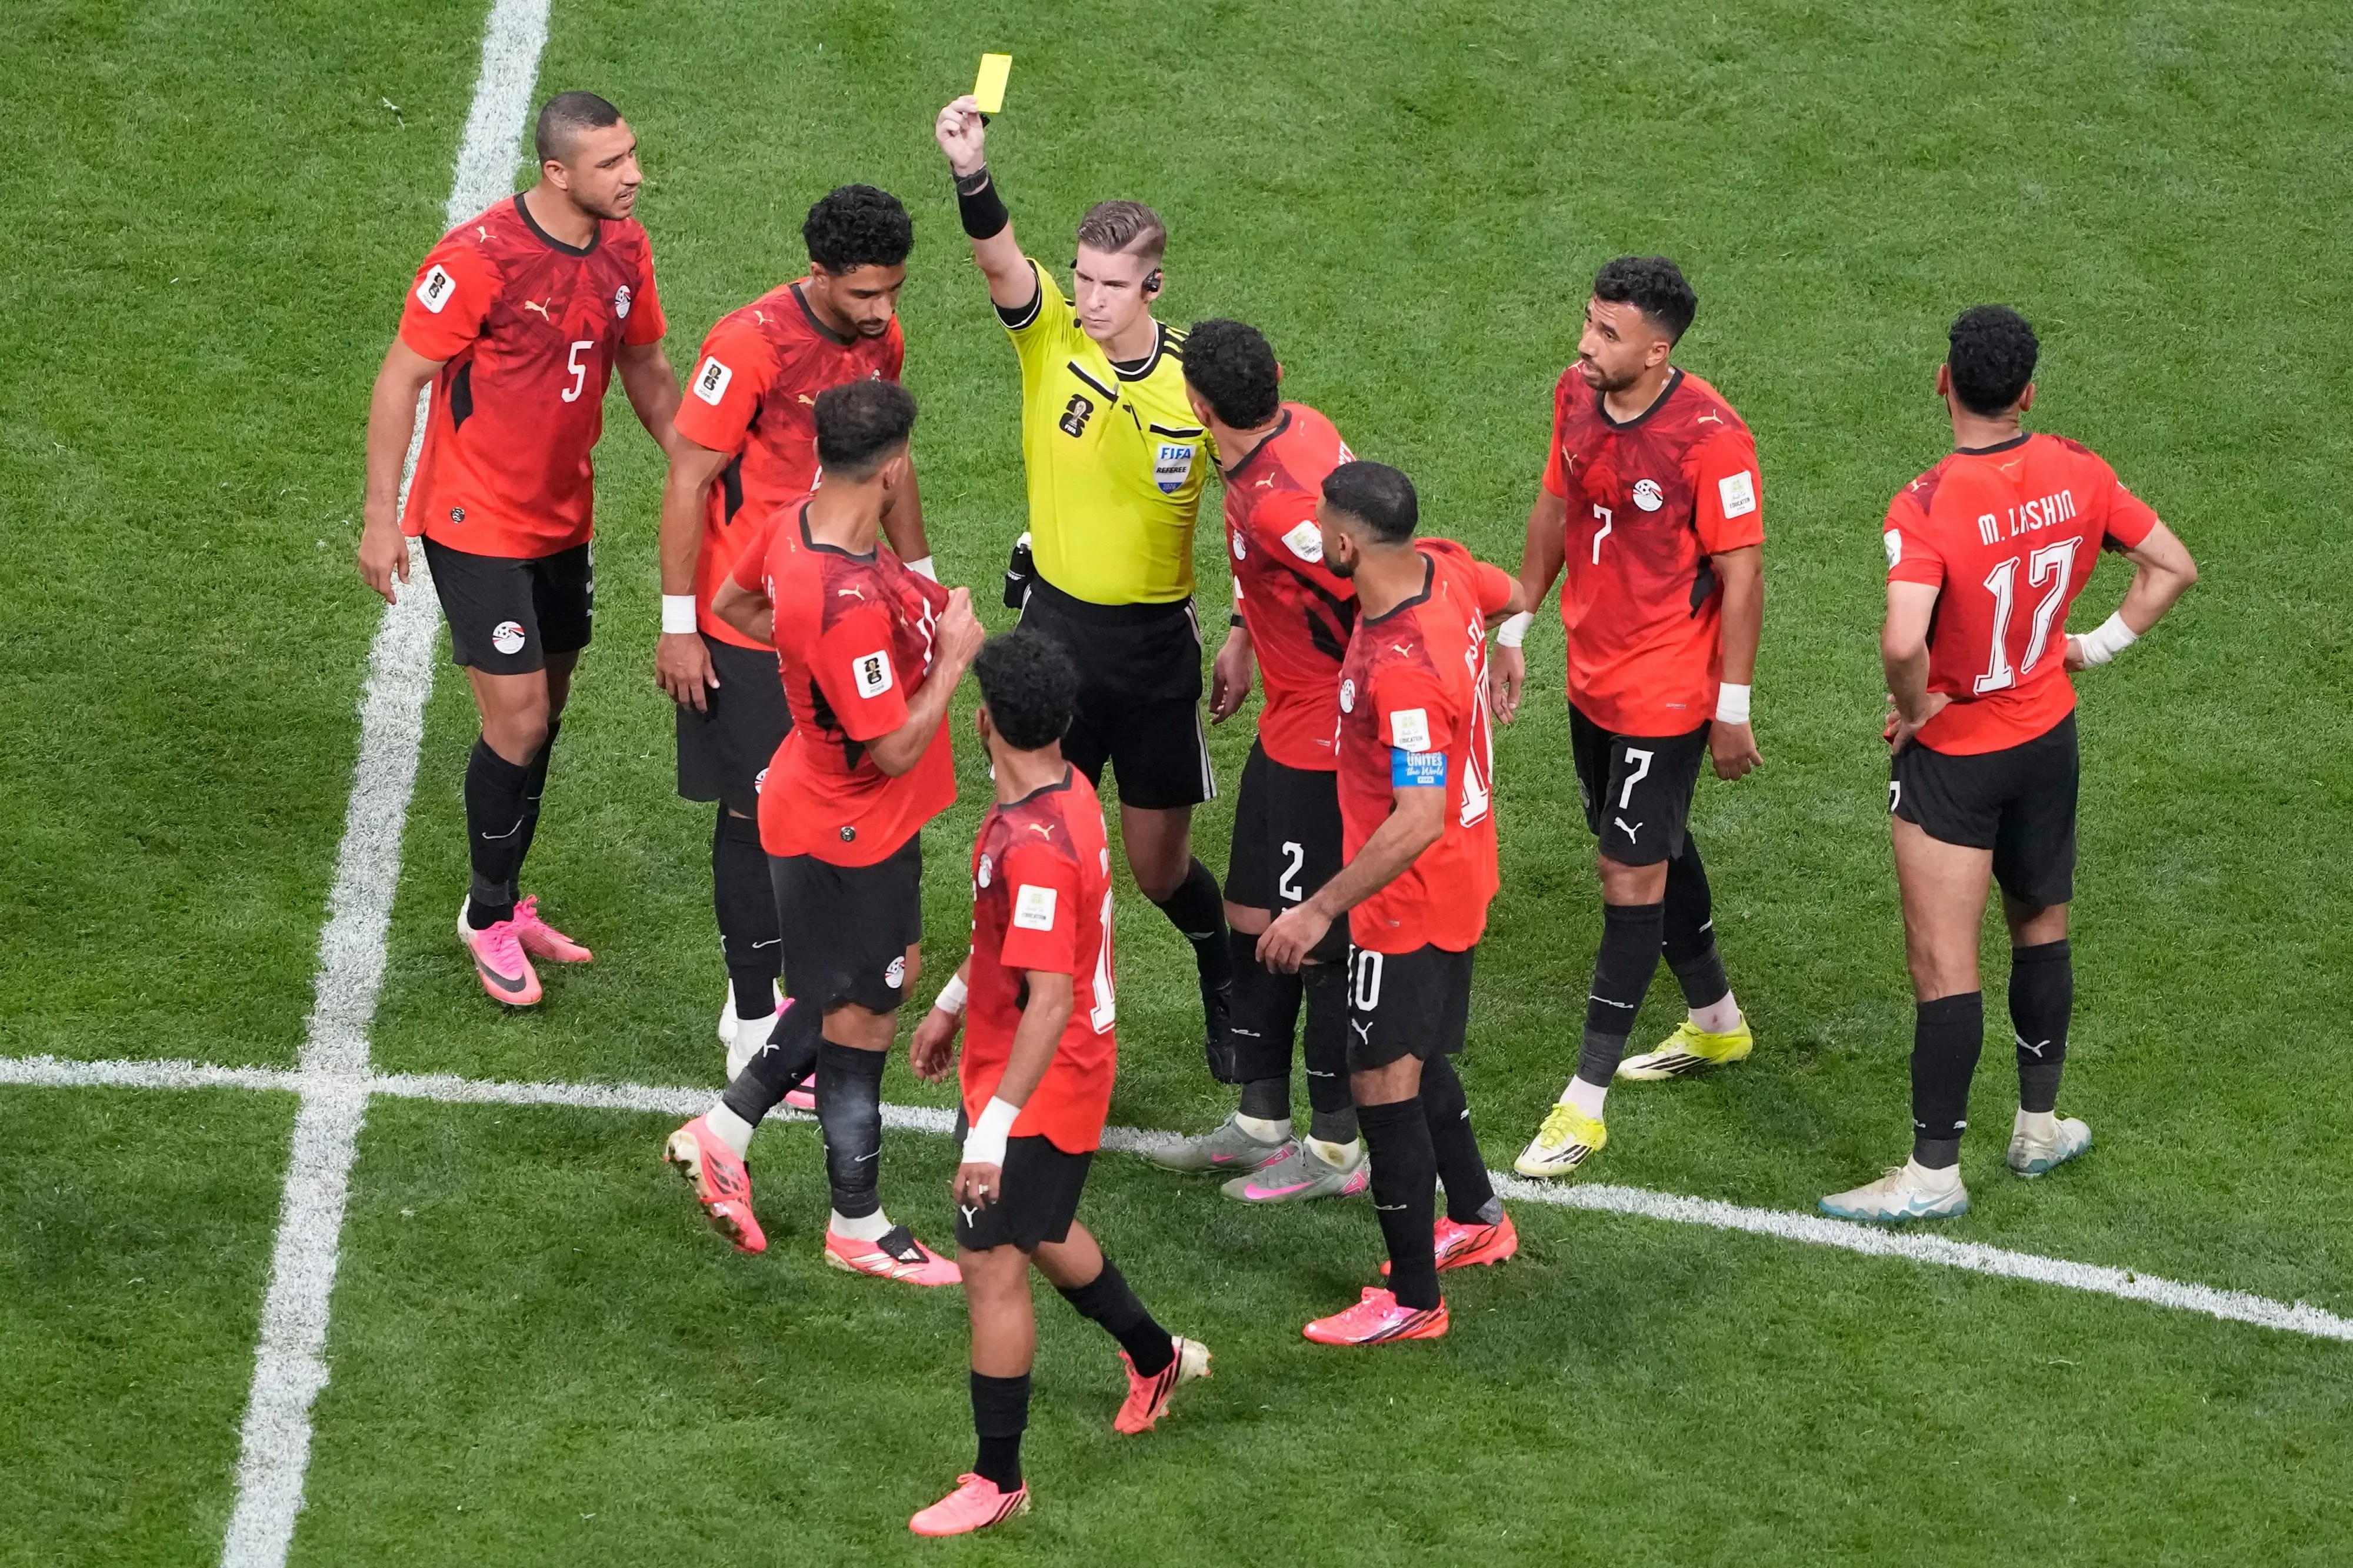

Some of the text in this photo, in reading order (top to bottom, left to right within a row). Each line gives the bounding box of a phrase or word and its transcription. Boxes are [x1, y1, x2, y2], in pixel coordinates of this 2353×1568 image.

[562, 341, 594, 403] 5
[1161, 447, 1191, 459] FIFA
[1592, 503, 1612, 565] 7
[1978, 489, 2077, 546] M. LASHIN
[1972, 535, 2084, 696] 17
[1407, 755, 1443, 767] UNITES
[1619, 747, 1654, 809] 7
[1279, 840, 1304, 902] 2
